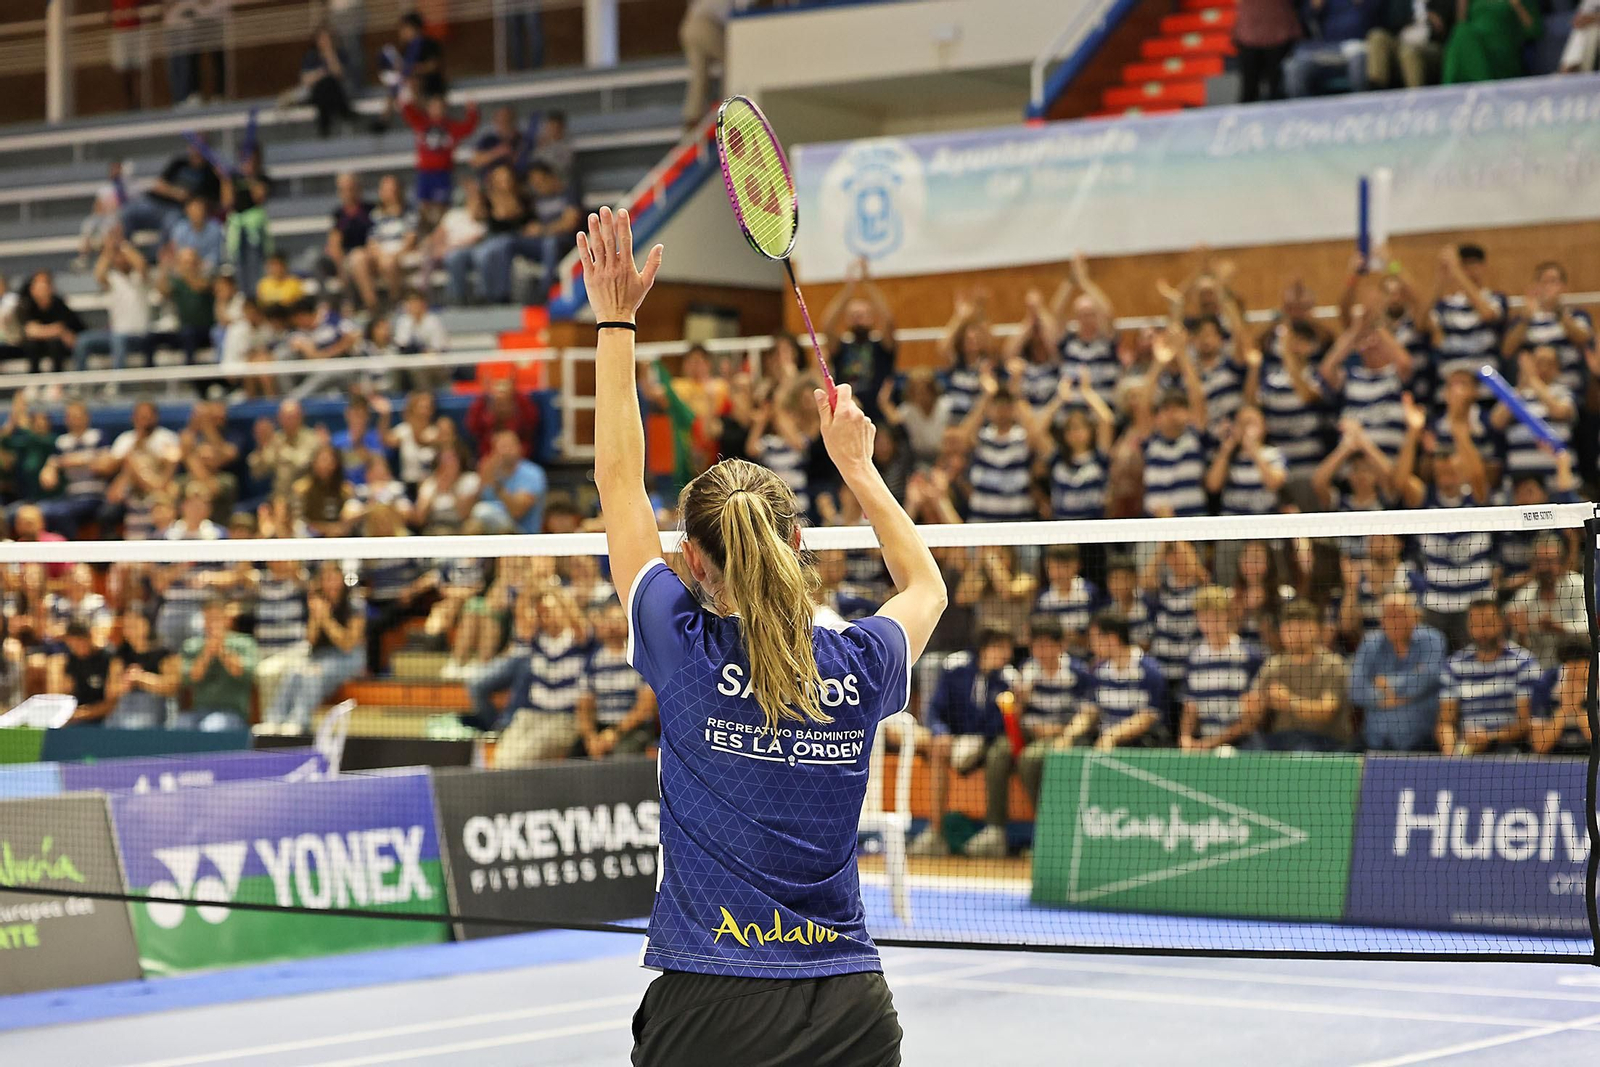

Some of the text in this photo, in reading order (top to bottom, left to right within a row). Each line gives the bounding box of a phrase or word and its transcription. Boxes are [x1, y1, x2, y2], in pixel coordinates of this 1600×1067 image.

[717, 663, 860, 707] SAOS
[704, 728, 863, 758] IES LA ORDEN
[707, 717, 865, 741] RECREATIVO BÁDMINTON
[1393, 787, 1592, 864] Huelv
[253, 825, 433, 909] YONEX
[470, 851, 660, 895] FITNESS CLU
